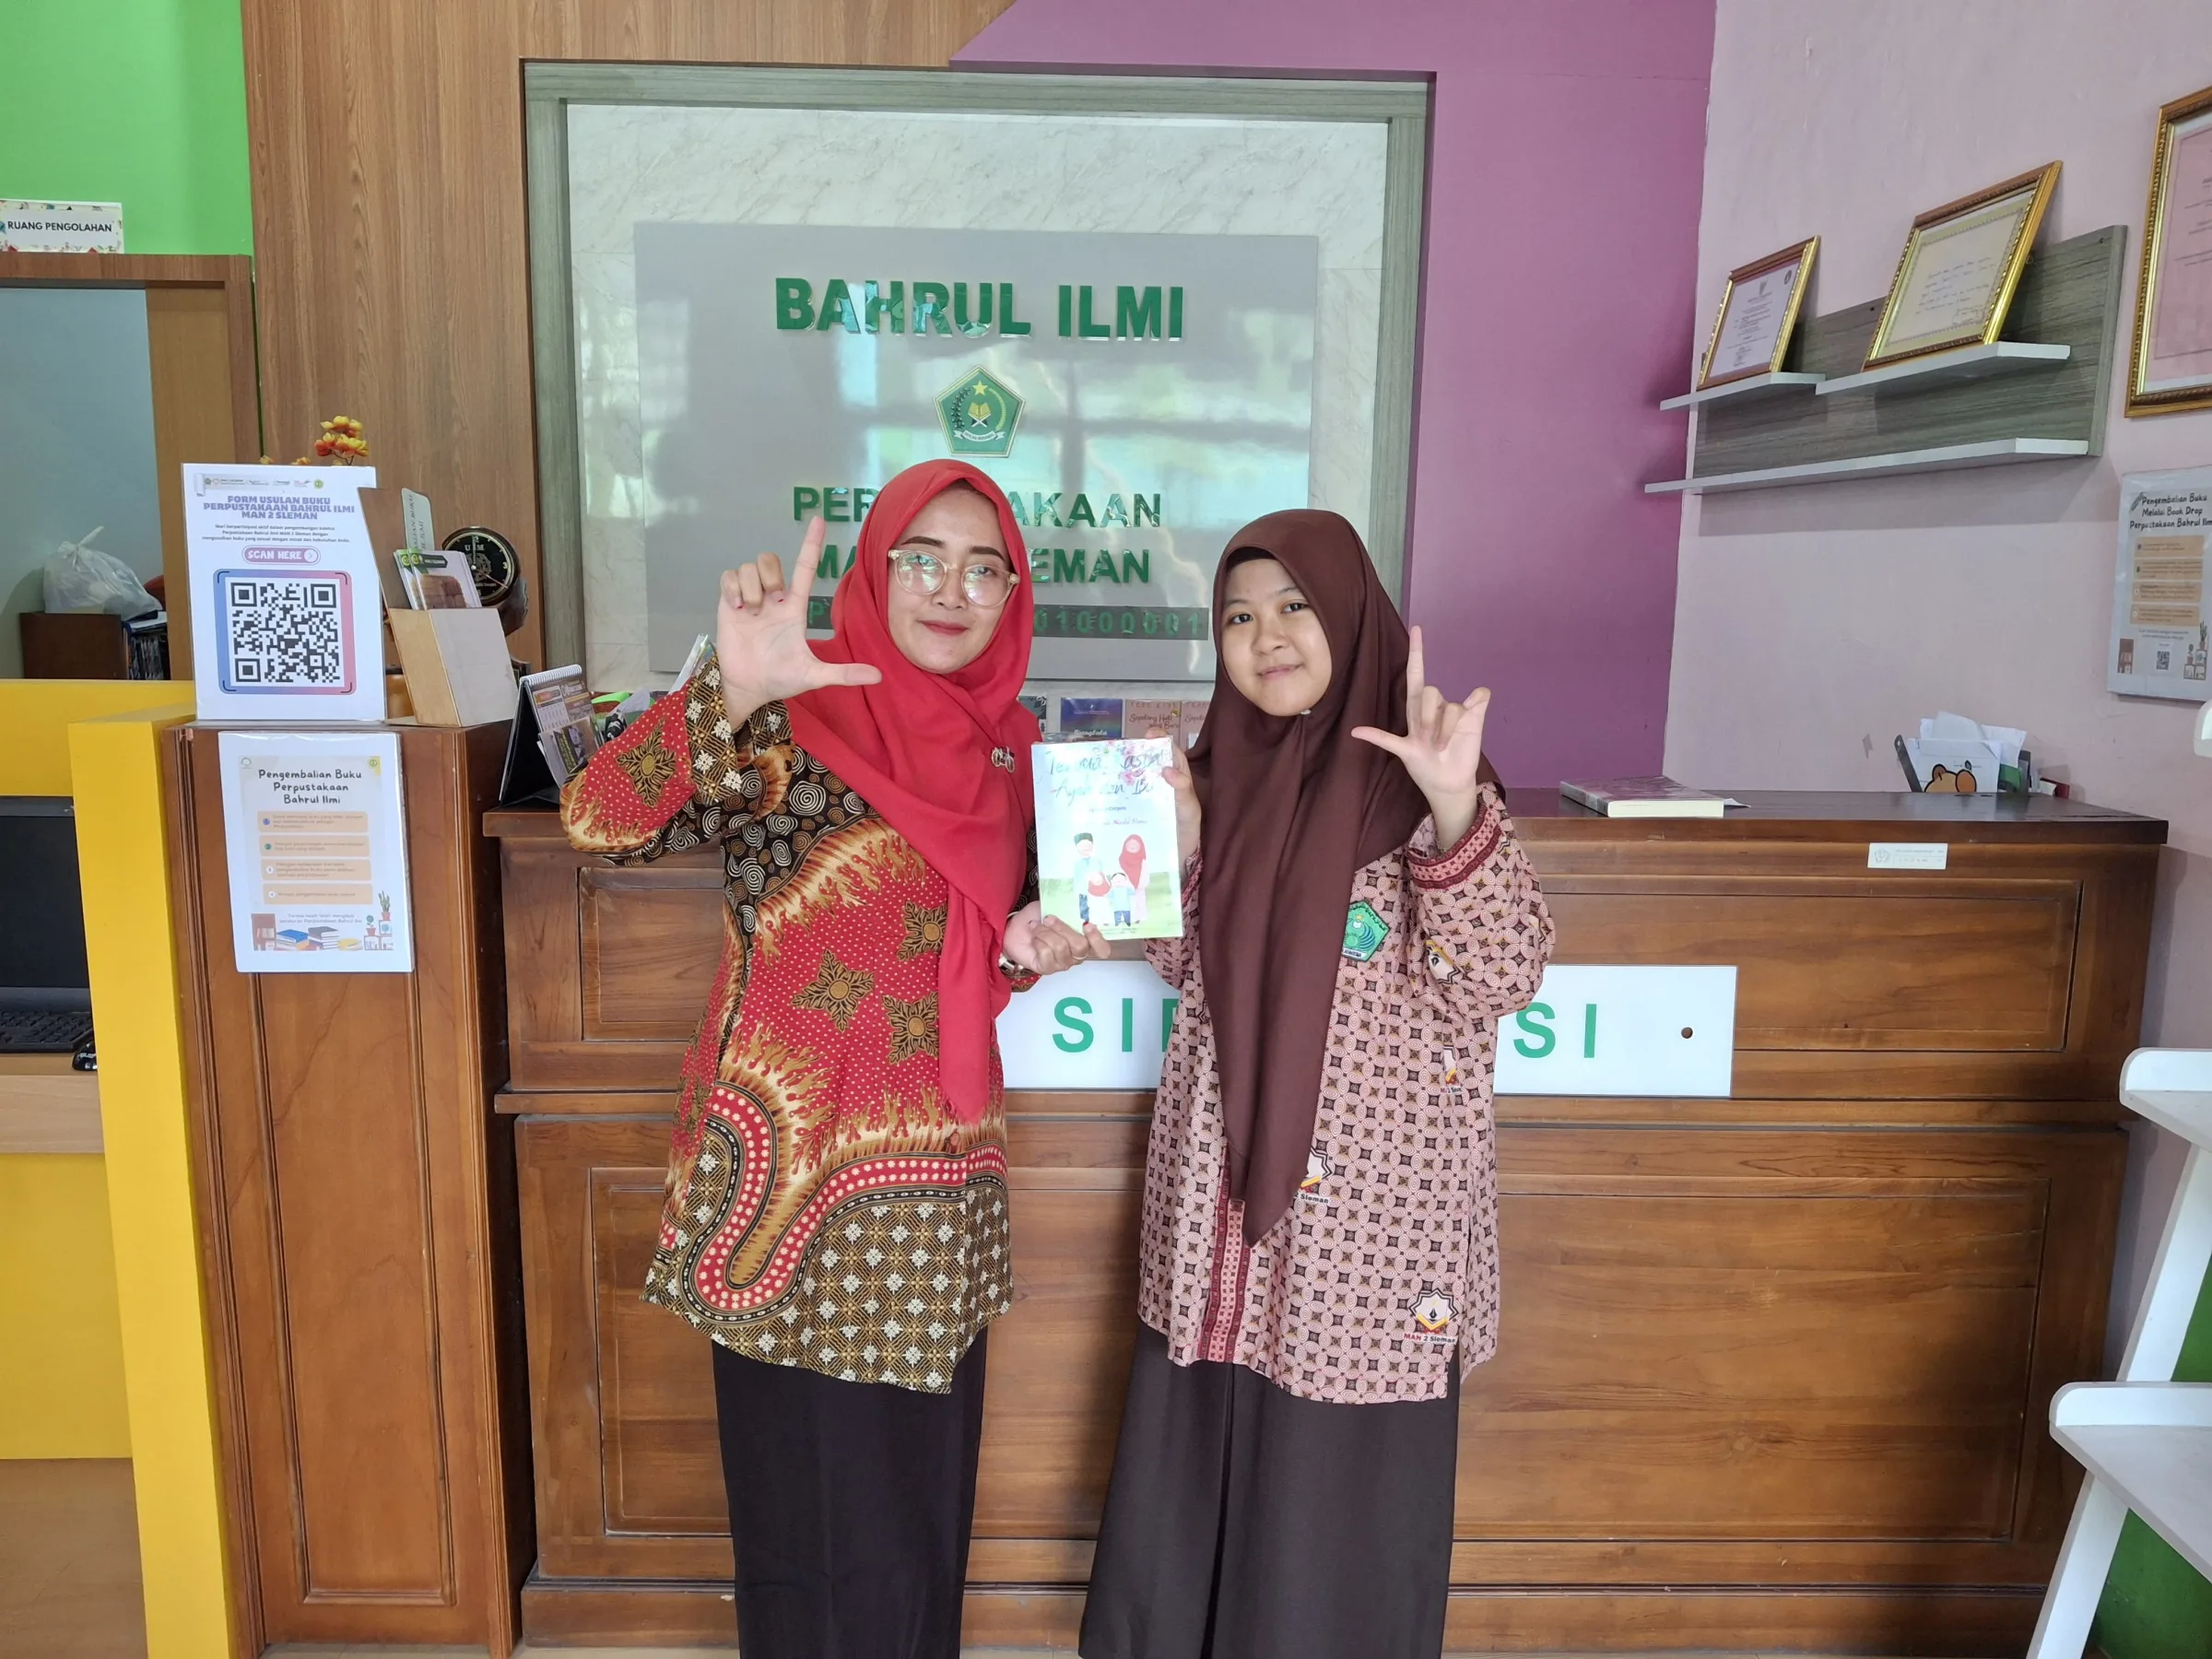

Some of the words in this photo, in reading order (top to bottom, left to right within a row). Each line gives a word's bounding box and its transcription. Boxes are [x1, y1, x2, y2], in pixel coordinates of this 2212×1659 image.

[7, 220, 42, 230] RUANG
[45, 221, 112, 232] PENGOLAHAN
[774, 277, 1032, 339] BAHRUL
[1057, 285, 1184, 341] ILMI
[260, 496, 300, 504] USULAN
[2142, 494, 2188, 507] Pengembalian
[2189, 493, 2207, 502] Buku
[204, 503, 288, 512] PERPUSTAKAAN
[290, 504, 332, 512] BAHRUL
[334, 505, 355, 513] ILMI
[2167, 506, 2183, 516] Book
[2185, 506, 2203, 516] Drop
[241, 511, 265, 519] MAN
[2129, 520, 2175, 531] Perpustakaan
[2177, 517, 2201, 528] Bahrul
[248, 550, 275, 559] SCAN
[277, 550, 302, 559] HERE
[258, 769, 332, 781] Pengembalian
[335, 769, 362, 779] Buku
[273, 782, 349, 794] Perpustakaan
[284, 794, 319, 804] Bahrul
[322, 794, 341, 804] Ilmi
[1300, 1193, 1329, 1204] Sleman
